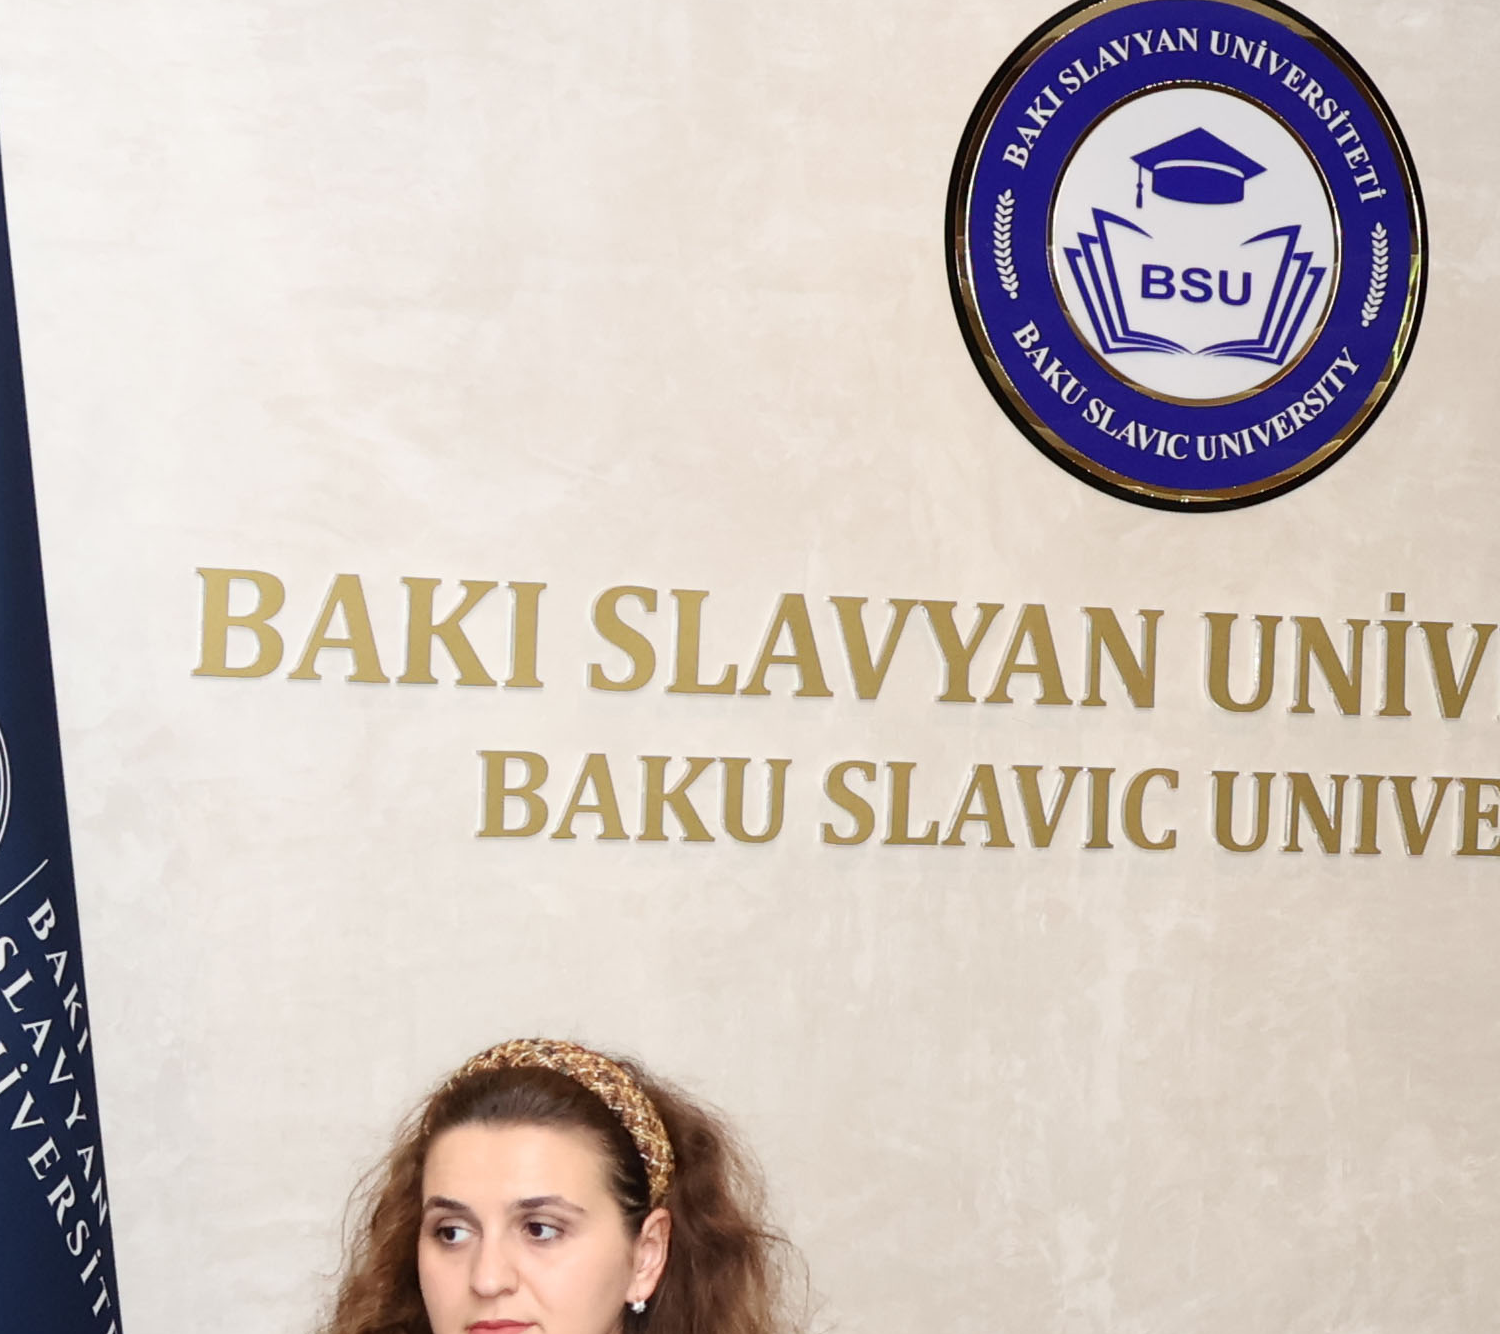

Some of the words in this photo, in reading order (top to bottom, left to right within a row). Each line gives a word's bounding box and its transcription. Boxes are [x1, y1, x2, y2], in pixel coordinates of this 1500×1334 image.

[1002, 86, 1063, 170] BAKI
[1058, 26, 1199, 95] SLAVYAN
[1209, 30, 1387, 204] UNİVERSİTETİ
[1140, 264, 1252, 306] BSU
[1013, 320, 1089, 405] BAKU
[1082, 398, 1190, 460] SLAVIC
[1196, 346, 1360, 462] UNIVERSITY
[195, 566, 547, 690] BAKI
[588, 584, 1165, 710] SLAVYAN
[474, 748, 793, 844] BAKU
[820, 759, 1180, 852] SLAVIC
[27, 898, 89, 1054] BAKI
